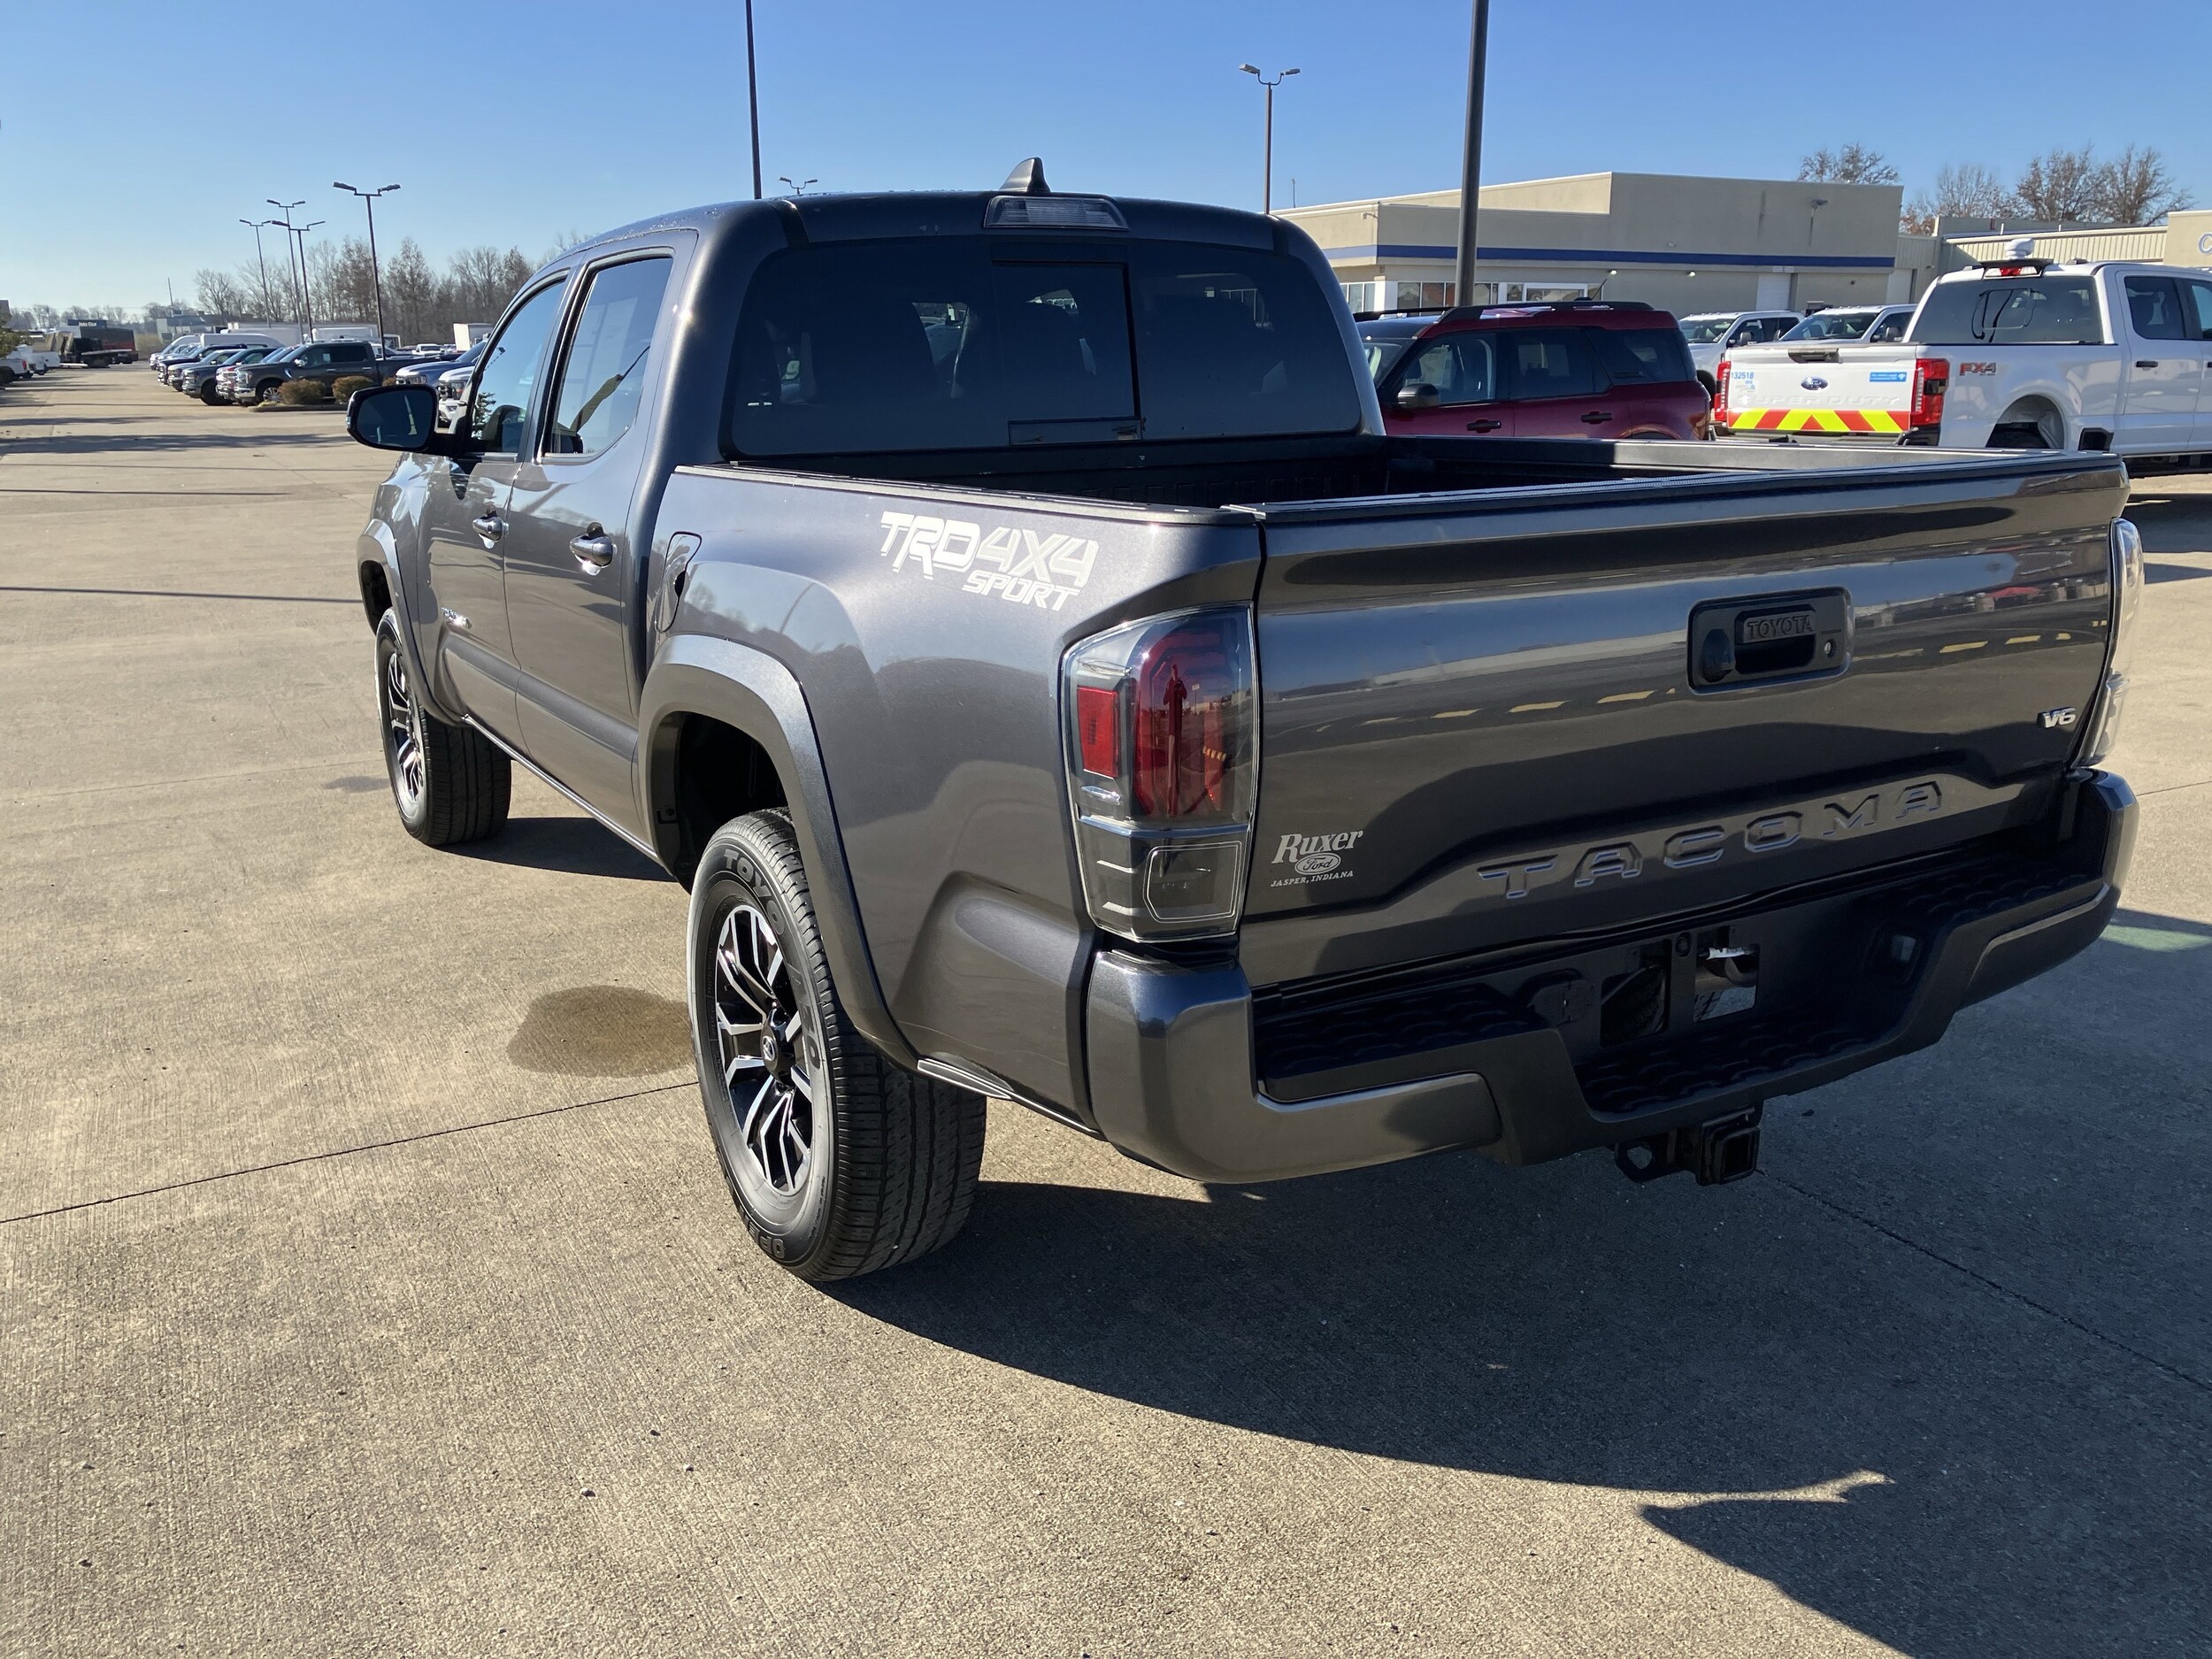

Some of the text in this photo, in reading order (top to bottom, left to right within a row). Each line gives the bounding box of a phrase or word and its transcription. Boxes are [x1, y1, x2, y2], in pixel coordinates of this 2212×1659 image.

[1731, 371, 1755, 380] 132518
[1959, 362, 1997, 376] FX4
[1826, 396, 1900, 405] DUTY
[961, 570, 1083, 611] SPORT
[1747, 614, 1813, 641] TOYOTA
[2038, 707, 2077, 728] V6
[1271, 830, 1363, 864] Ruxer
[1476, 780, 1943, 900] TACOMA
[1302, 855, 1334, 871] Ford
[1271, 870, 1354, 887] JASPER, INDIANA
[723, 849, 786, 936] TOYO
